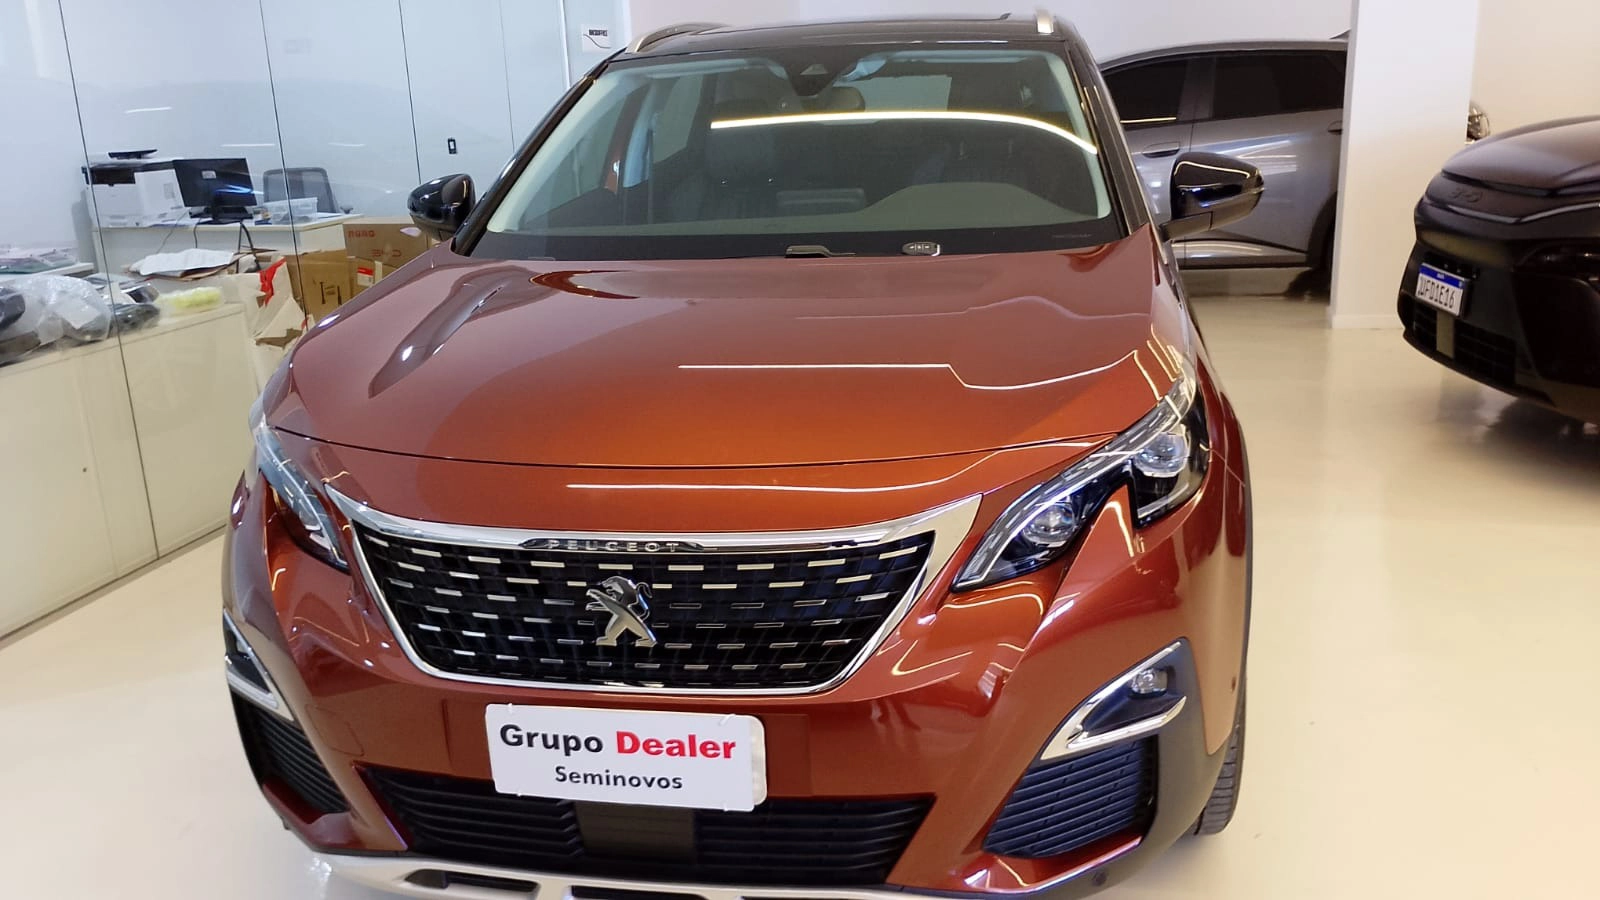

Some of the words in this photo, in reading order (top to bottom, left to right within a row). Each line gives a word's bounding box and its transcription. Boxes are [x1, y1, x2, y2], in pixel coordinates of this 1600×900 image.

[547, 539, 679, 552] PEUGEOT
[500, 724, 604, 756] Grupo
[616, 731, 736, 759] Dealer
[555, 766, 683, 789] Seminovos
